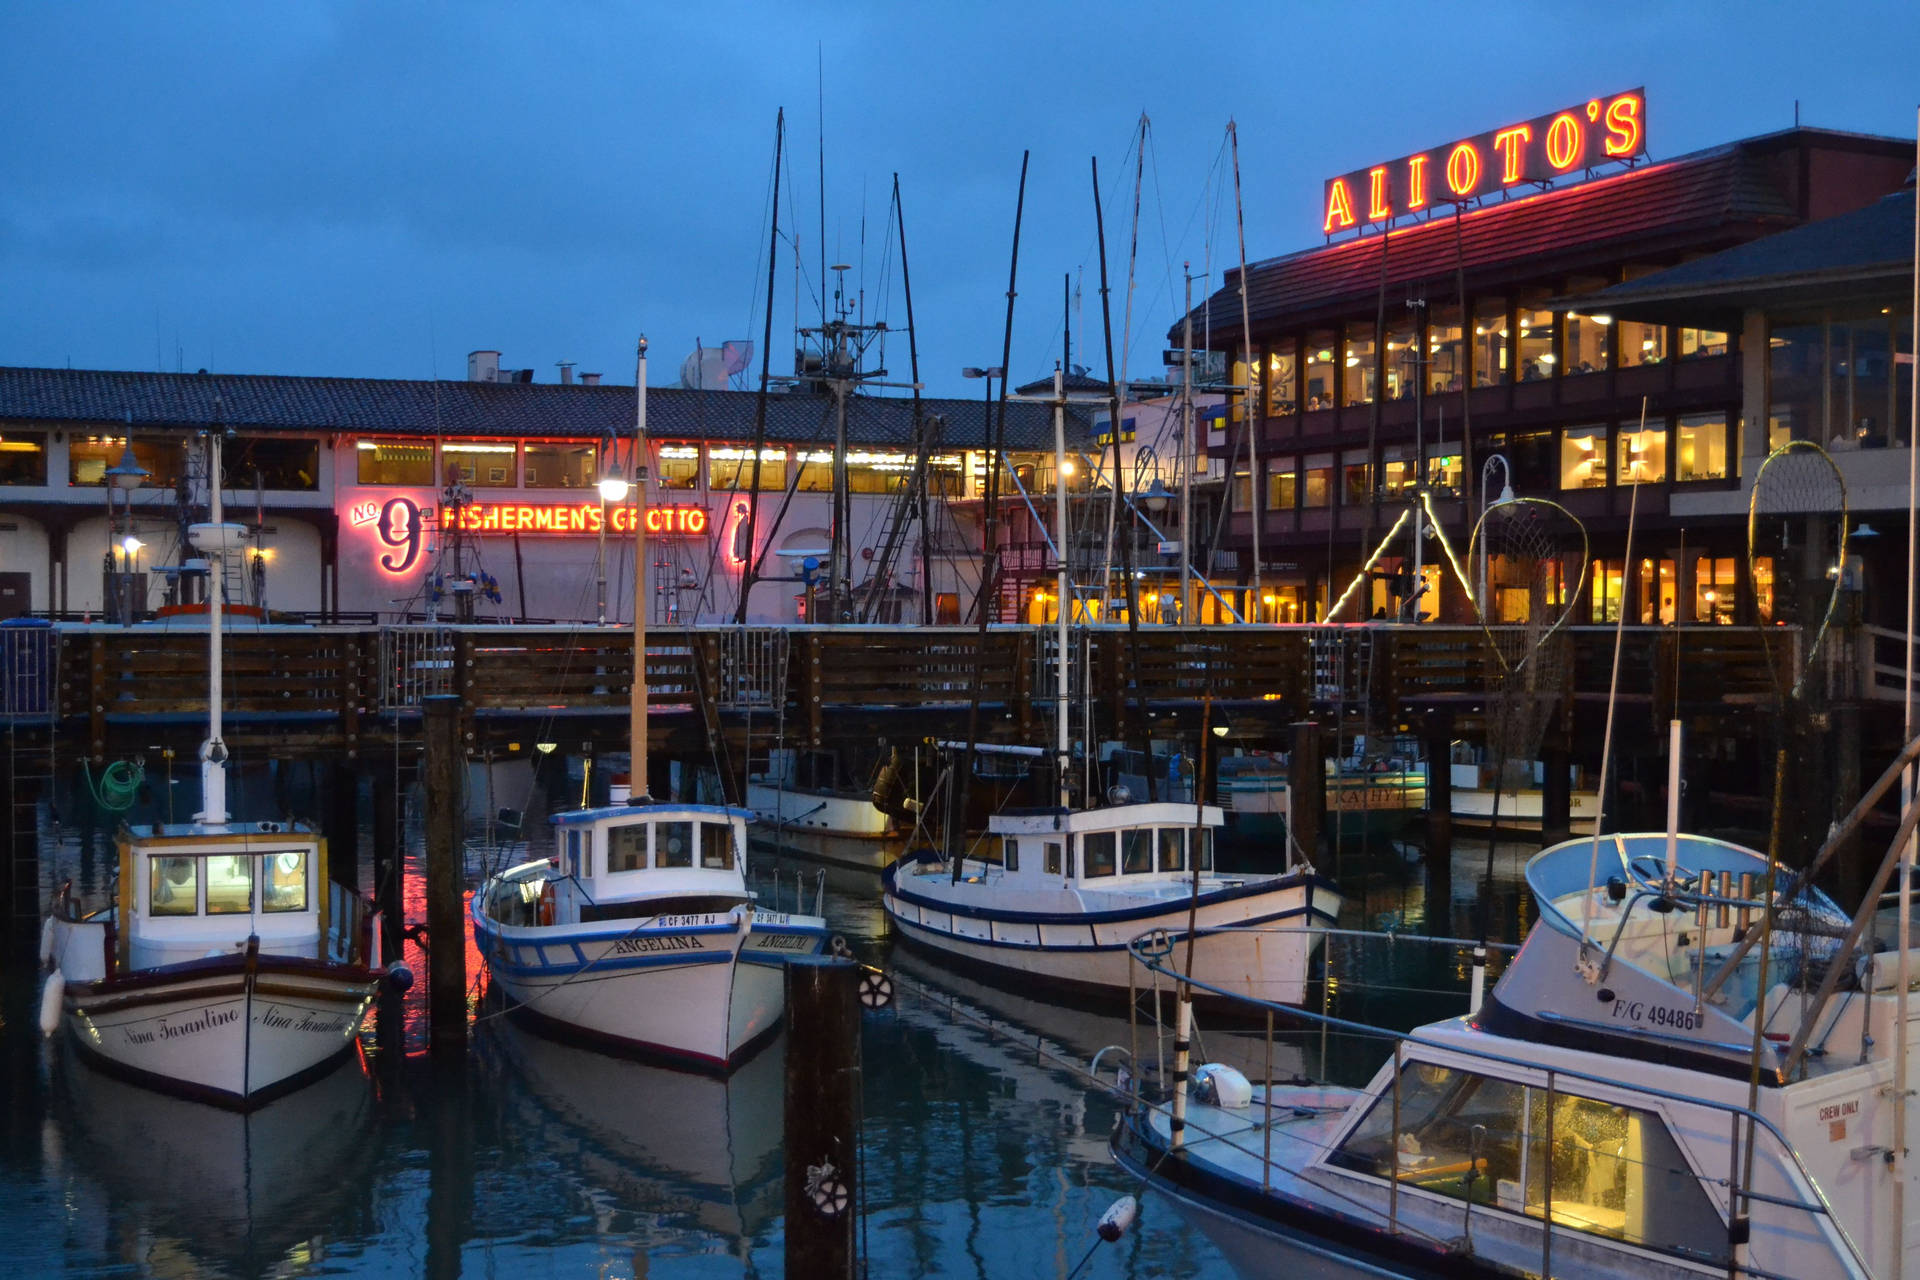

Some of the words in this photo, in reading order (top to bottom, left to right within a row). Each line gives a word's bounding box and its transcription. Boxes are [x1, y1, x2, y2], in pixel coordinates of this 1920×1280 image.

[1324, 96, 1640, 233] ALIOTO'S
[377, 497, 422, 572] 9
[443, 504, 601, 531] FISHERMEN'S
[1335, 788, 1392, 803] KAHY
[668, 916, 679, 926] CF
[681, 915, 699, 926] 3477
[704, 914, 716, 925] AJ
[615, 936, 705, 954] ANGELINA
[157, 1007, 239, 1041] Tarantino
[253, 1005, 293, 1030] Nina
[1612, 999, 1645, 1021] F/G
[1647, 1005, 1695, 1031] 49486
[1819, 1104, 1841, 1121] CREW
[1841, 1100, 1860, 1116] ONLY
